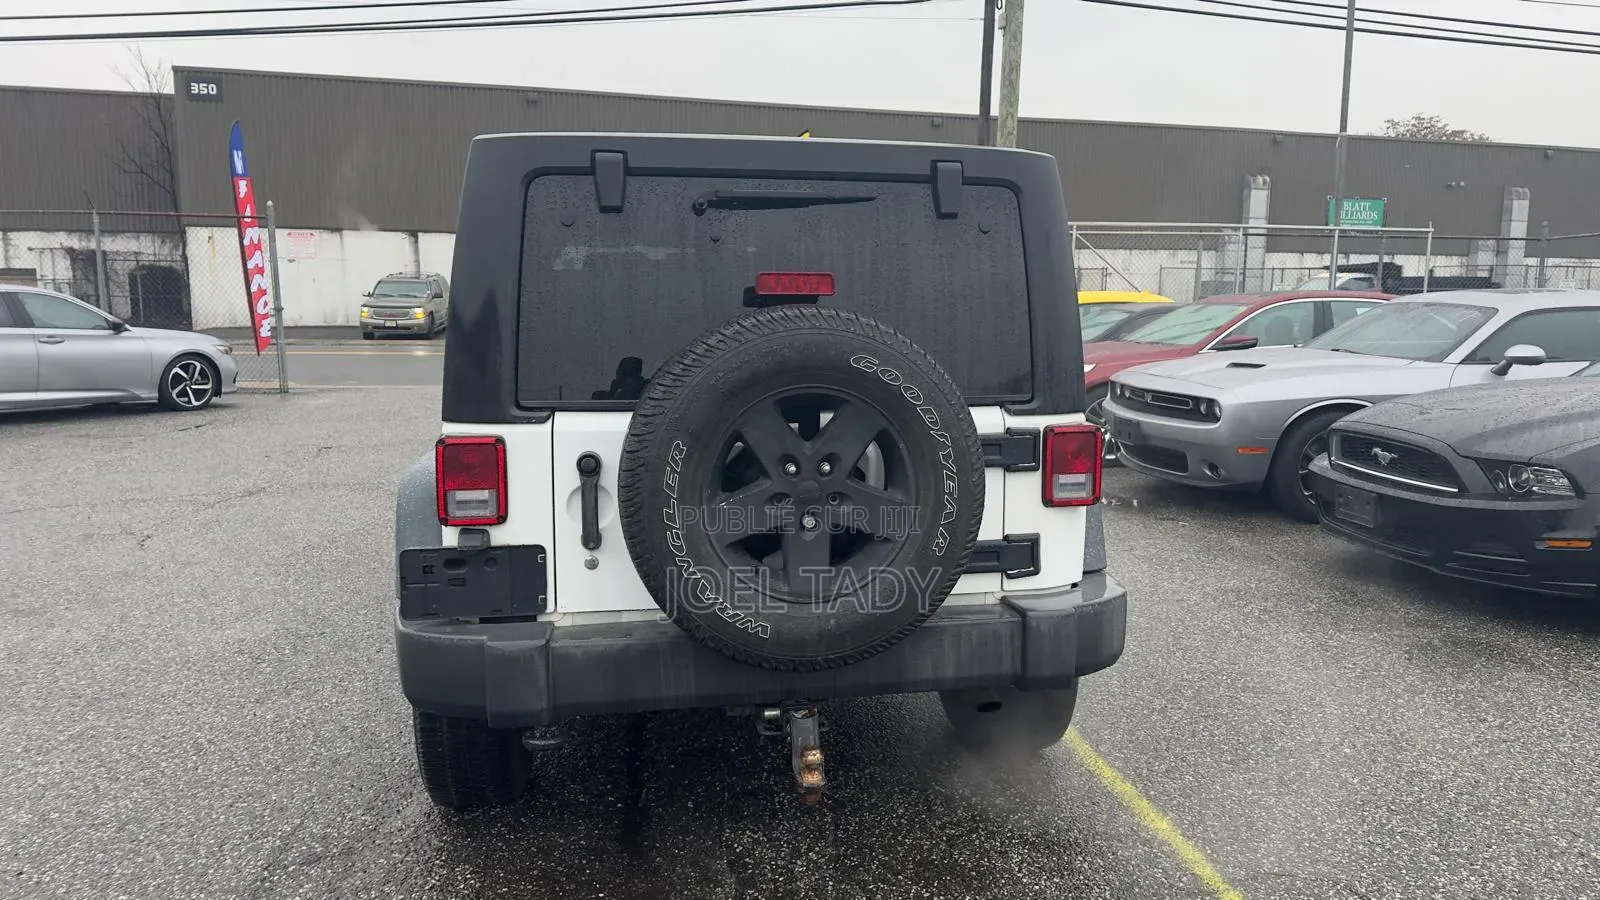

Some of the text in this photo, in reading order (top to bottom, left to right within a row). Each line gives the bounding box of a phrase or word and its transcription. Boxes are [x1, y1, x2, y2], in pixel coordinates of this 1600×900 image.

[190, 82, 217, 95] 350
[1343, 201, 1371, 210] BLATT
[1340, 210, 1378, 220] ILLIARDS
[850, 354, 958, 557] GOODYEAR
[662, 439, 771, 639] WRANGLER
